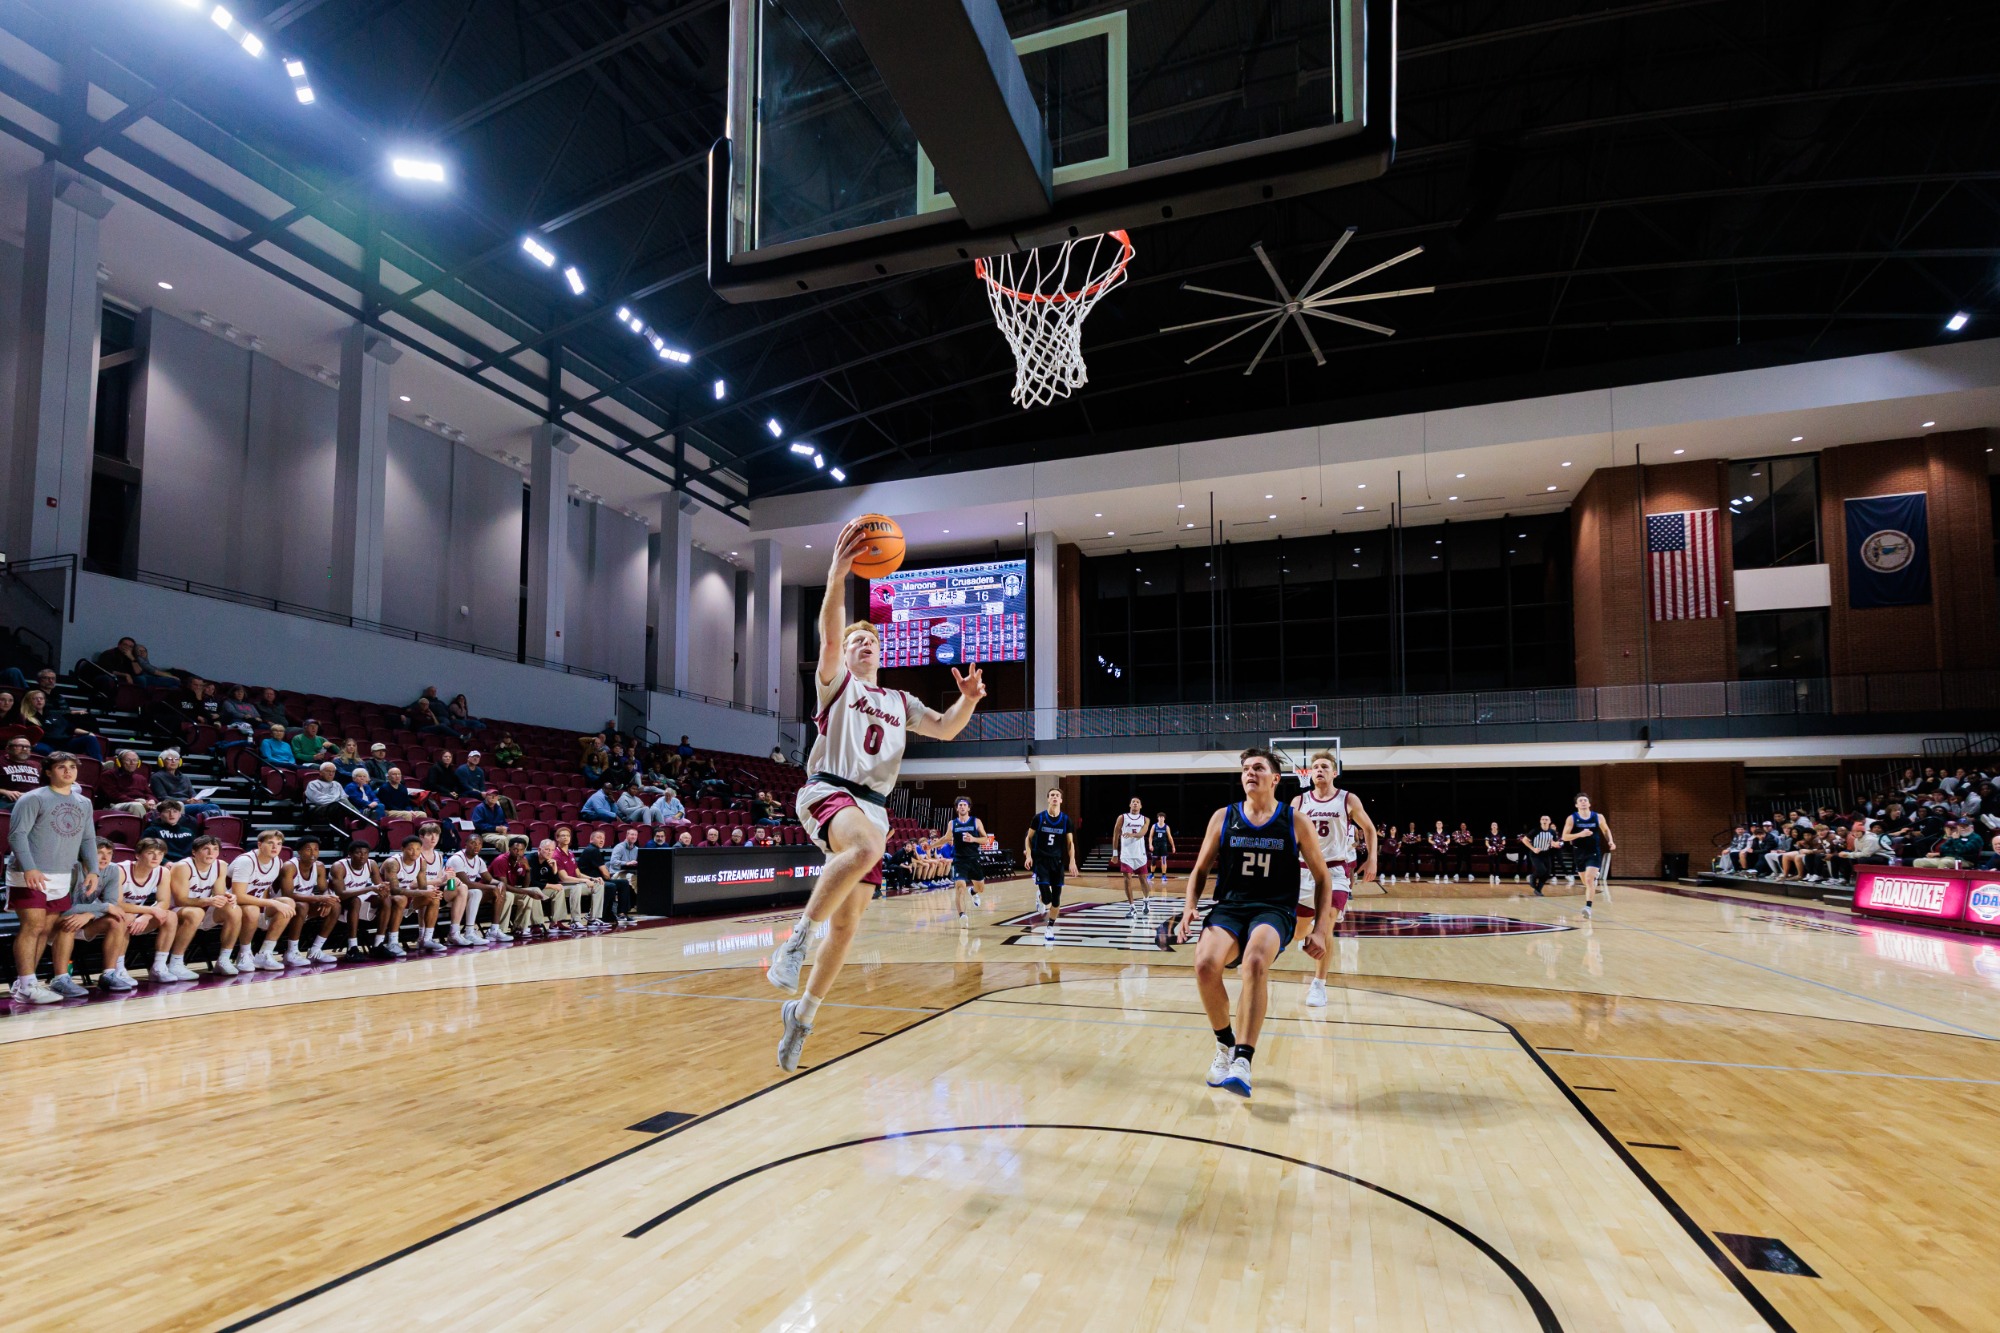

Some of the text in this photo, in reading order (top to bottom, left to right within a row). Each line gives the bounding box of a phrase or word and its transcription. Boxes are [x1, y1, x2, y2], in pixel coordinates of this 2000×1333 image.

[987, 563, 1019, 571] CENTER
[902, 581, 937, 591] Maroons
[951, 576, 995, 587] Crusaders
[935, 590, 958, 600] 17:45
[975, 591, 989, 602] 16
[903, 597, 917, 608] 57
[849, 696, 901, 727] Maroons
[863, 724, 885, 755] 0
[3, 764, 40, 777] ROANOKE
[11, 774, 40, 784] COLLEGE
[1306, 808, 1341, 818] Maroons
[1047, 834, 1056, 846] 5
[1229, 836, 1285, 851] CRUSADERS
[1241, 852, 1271, 878] 24
[684, 875, 697, 884] THIS
[696, 874, 711, 883] GAME
[711, 874, 717, 882] IS
[717, 868, 759, 882] STREAMING
[759, 867, 775, 879] LIVE
[1871, 877, 1949, 913] ROANOKE
[1972, 892, 2000, 907] ODA
